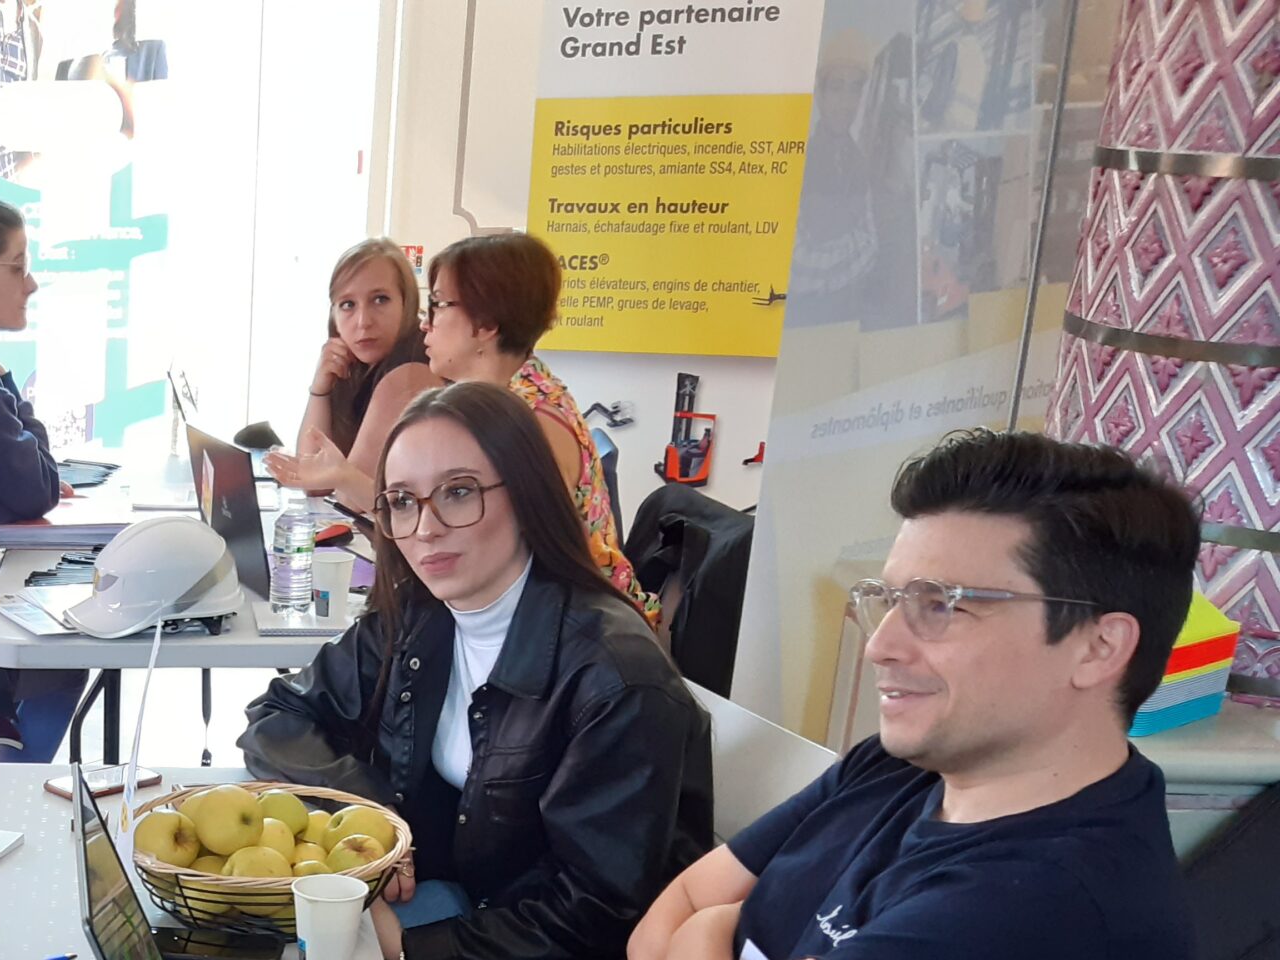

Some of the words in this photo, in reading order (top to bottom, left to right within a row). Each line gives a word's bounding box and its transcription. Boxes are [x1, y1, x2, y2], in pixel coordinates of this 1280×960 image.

[562, 6, 630, 28] Votre
[638, 0, 780, 31] partenaire
[560, 33, 641, 58] Grand
[650, 34, 687, 56] Est
[554, 120, 622, 140] Risques
[628, 117, 733, 139] particuliers
[552, 142, 620, 157] Habilitations
[624, 141, 690, 158] électriques,
[693, 141, 746, 157] incendie,
[749, 141, 774, 156] SST,
[777, 141, 805, 154] AIPR
[551, 163, 587, 177] gestes
[590, 163, 601, 175] et
[604, 163, 656, 177] postures,
[659, 162, 706, 175] amiante
[709, 162, 736, 176] SS4,
[738, 162, 767, 176] Atex,
[771, 161, 788, 174] RC
[548, 198, 620, 214] Travaux
[627, 201, 649, 214] en
[655, 197, 730, 214] hauteur
[546, 220, 590, 234] Harnais,
[594, 219, 666, 236] échafaudage
[669, 220, 690, 233] fixe
[693, 221, 705, 234] et
[708, 221, 752, 236] roulant,
[755, 221, 779, 234] LDV
[560, 277, 586, 289] riots
[589, 277, 649, 292] élévateurs,
[652, 279, 691, 294] engins
[694, 279, 708, 291] de
[711, 280, 761, 294] chantier,
[559, 296, 579, 308] elle
[582, 296, 614, 310] PEMP,
[617, 298, 649, 311] grues
[652, 298, 666, 310] de
[669, 299, 709, 313] levage,
[566, 315, 604, 327] roulant
